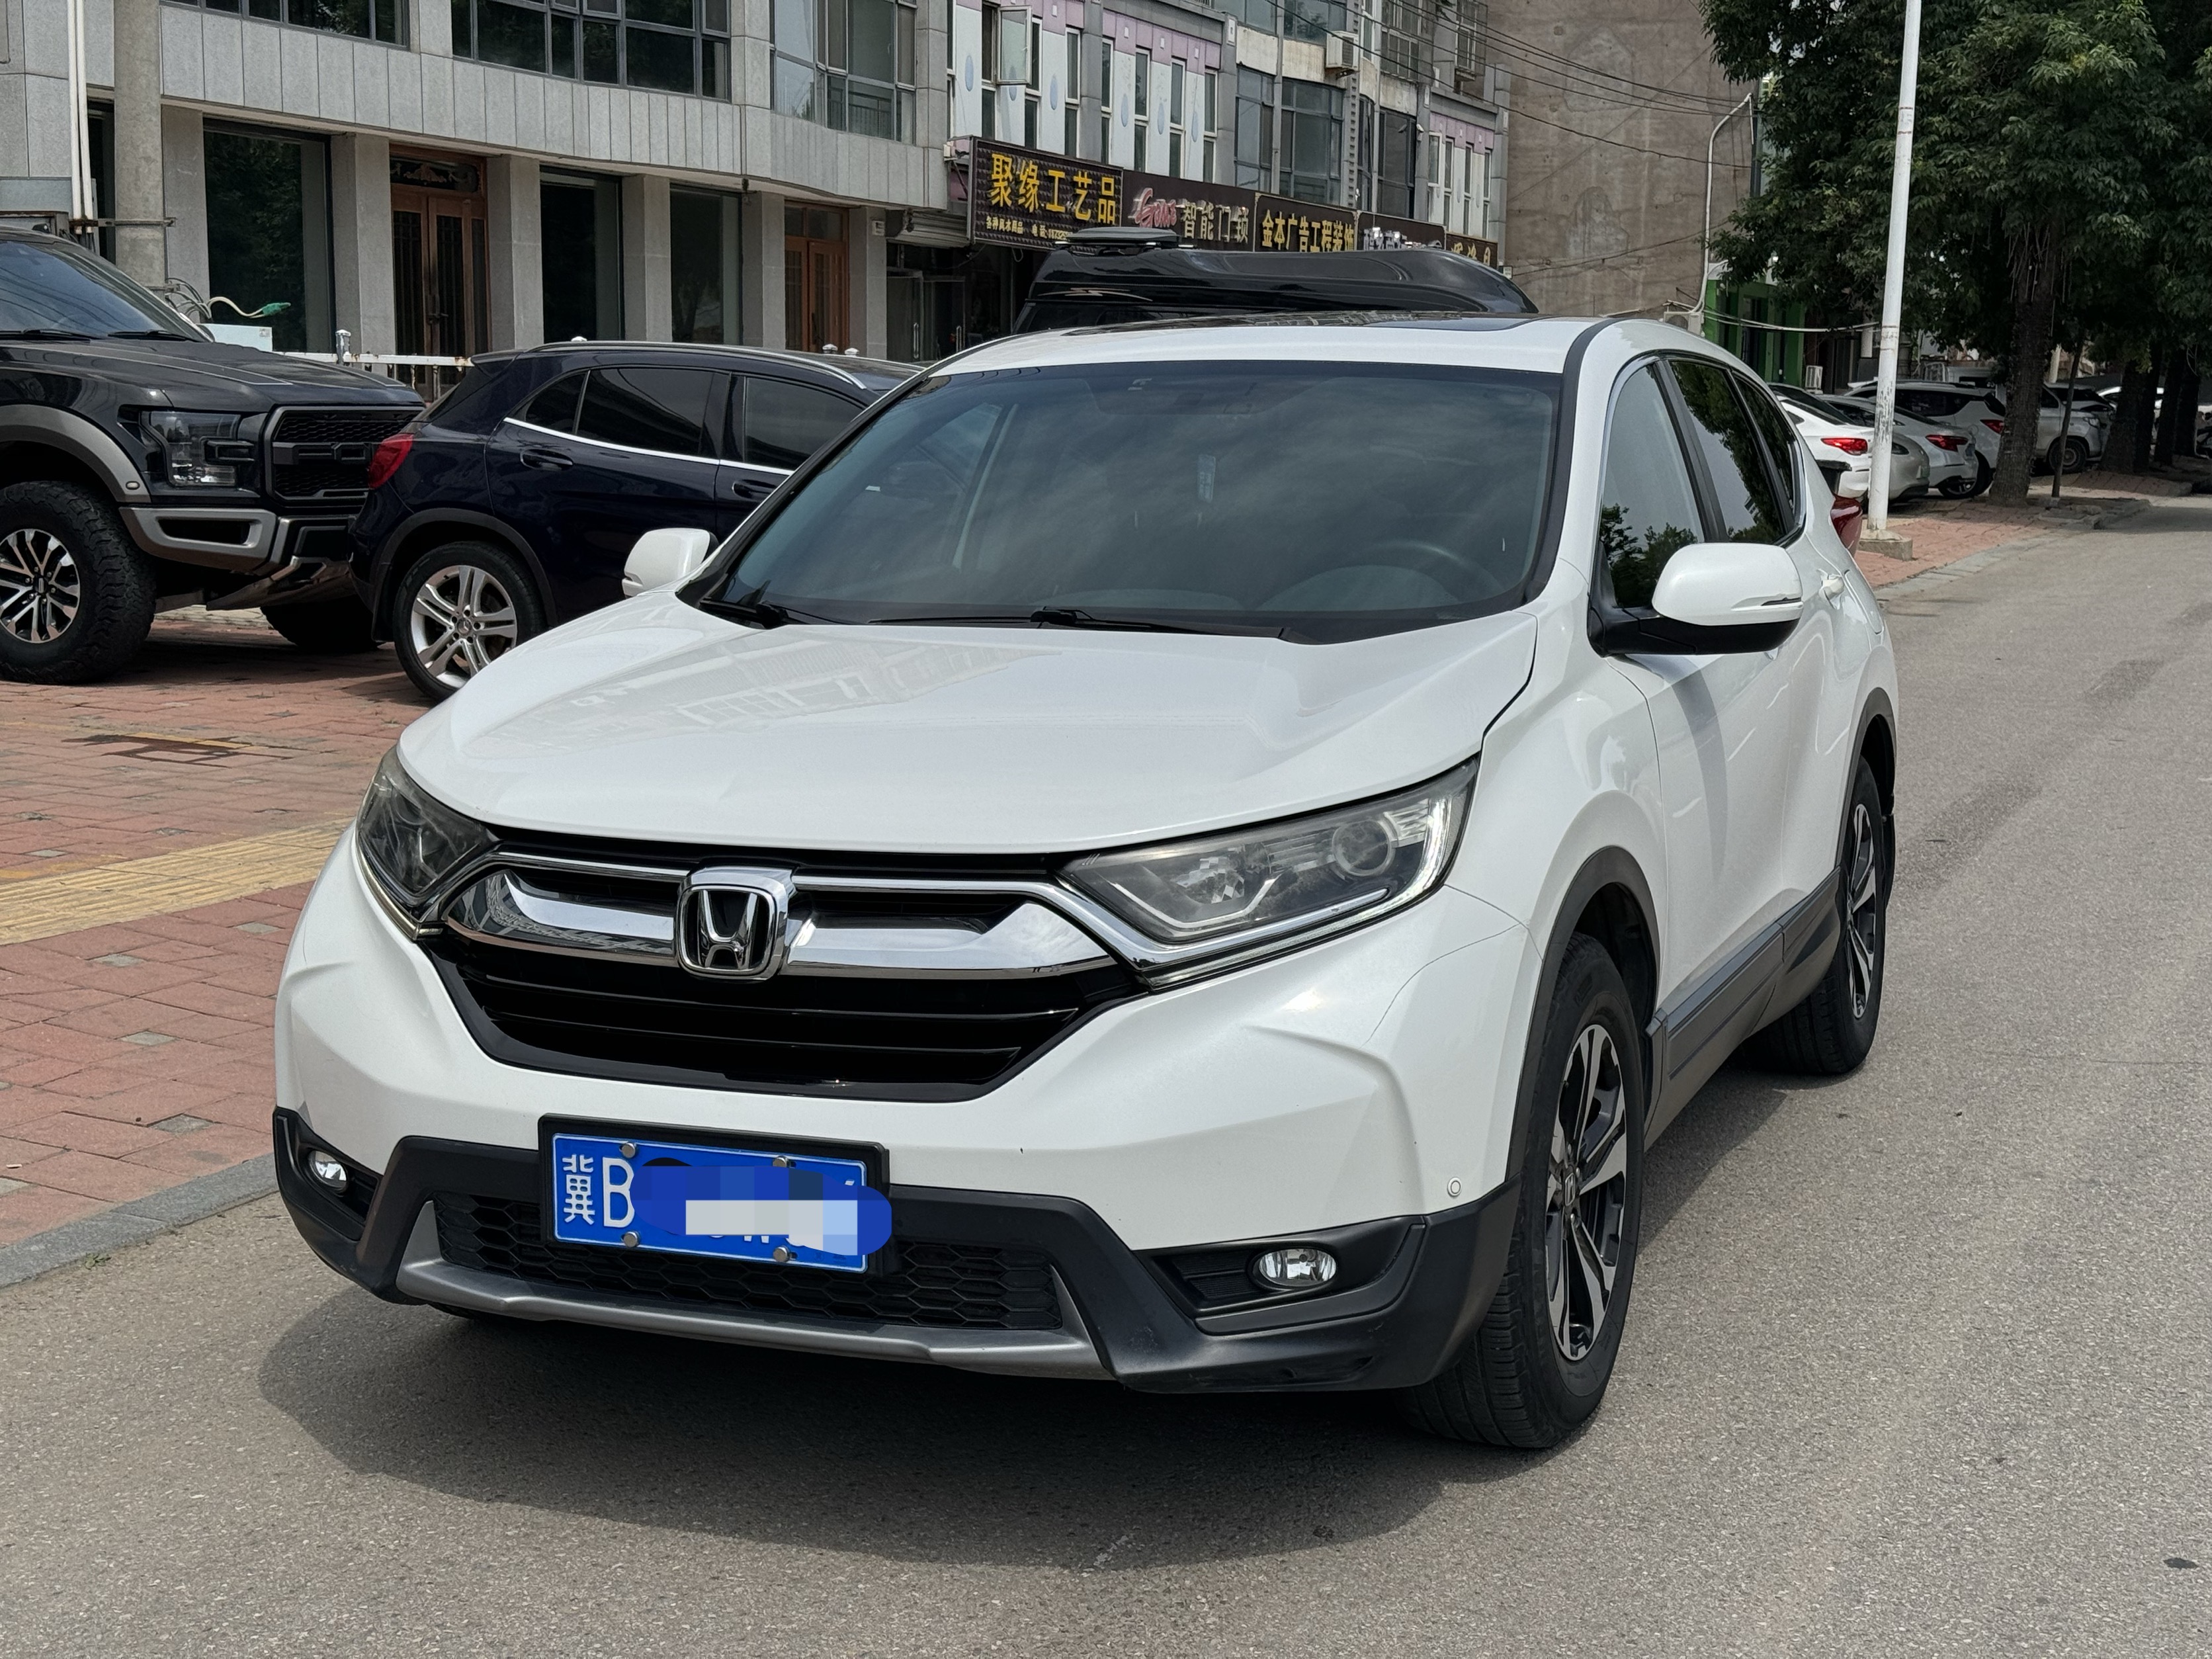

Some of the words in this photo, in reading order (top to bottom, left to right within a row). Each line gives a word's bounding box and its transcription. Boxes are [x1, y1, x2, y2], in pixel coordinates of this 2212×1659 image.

[988, 153, 1116, 225] 聚缘工艺品
[1182, 200, 1249, 244] 智能门锁
[1261, 209, 1354, 253] 金本广告工程装饰
